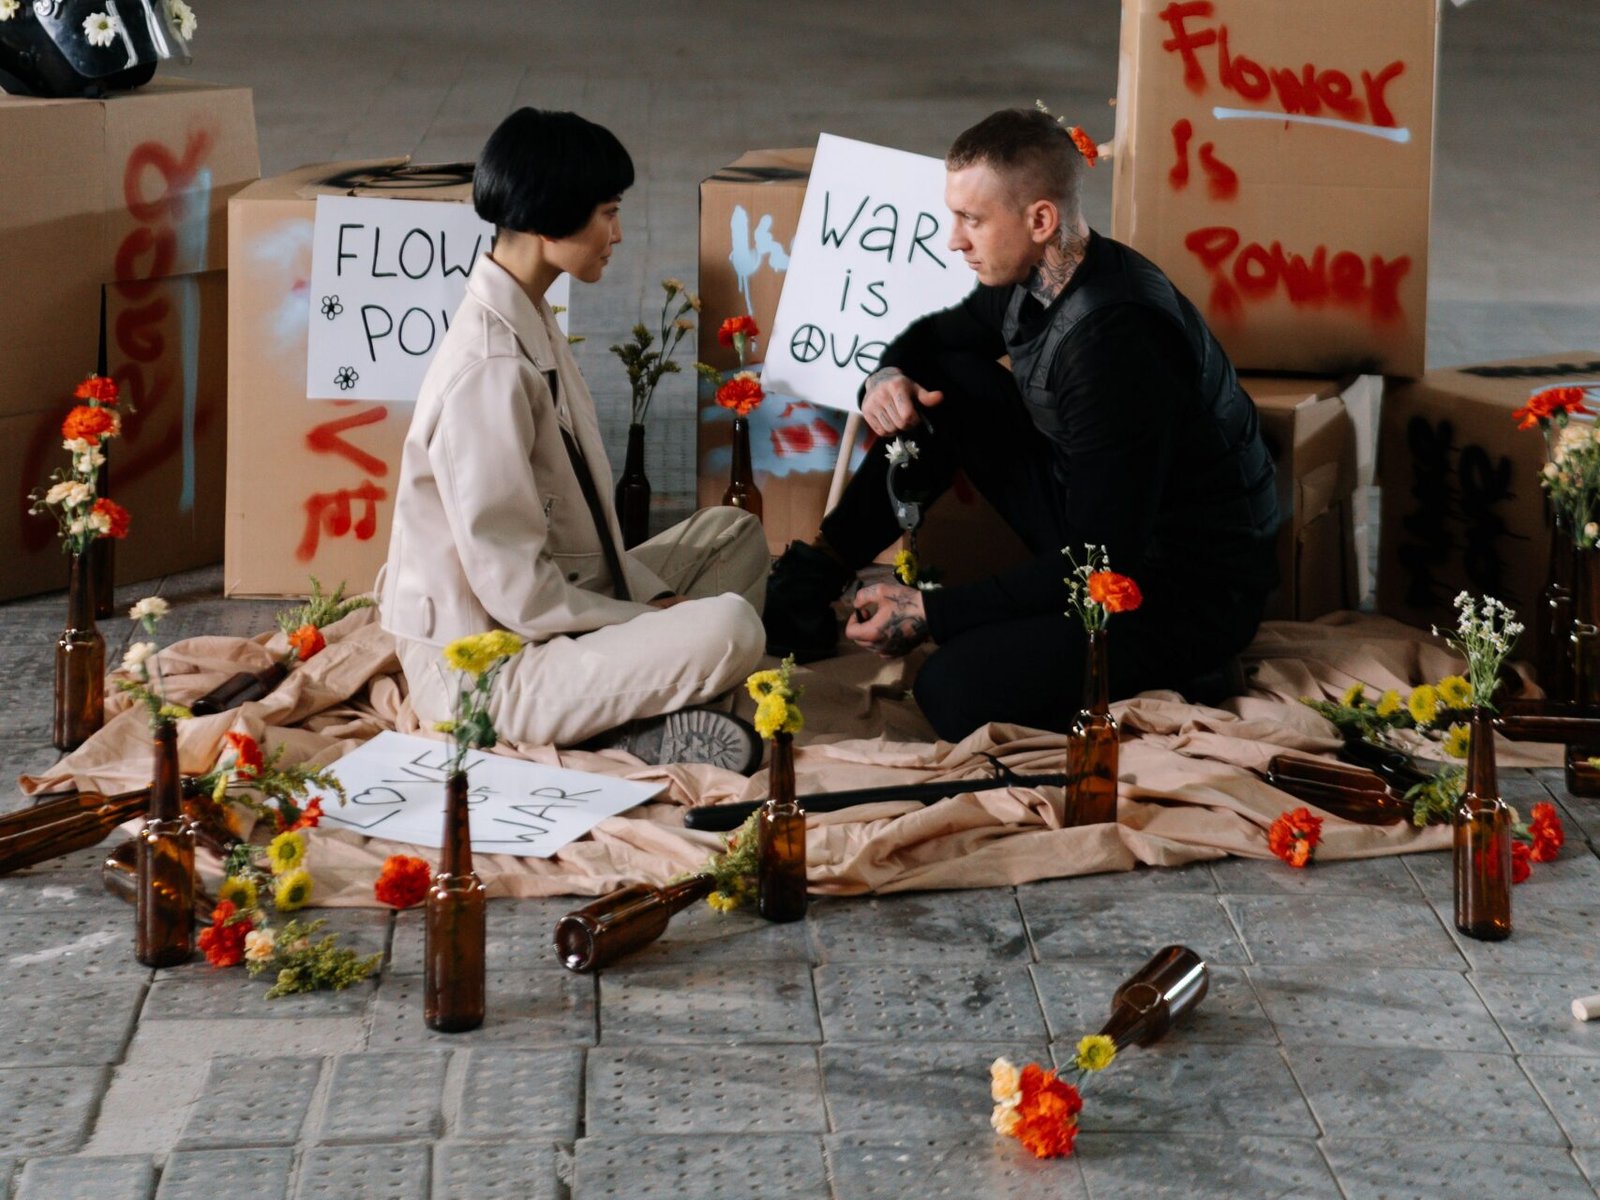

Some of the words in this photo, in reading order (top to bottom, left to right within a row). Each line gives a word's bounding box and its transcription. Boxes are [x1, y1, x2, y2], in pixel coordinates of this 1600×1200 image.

[1158, 0, 1406, 127] Flower
[336, 223, 497, 280] FLOW
[840, 268, 889, 317] is
[470, 786, 602, 843] WAR
